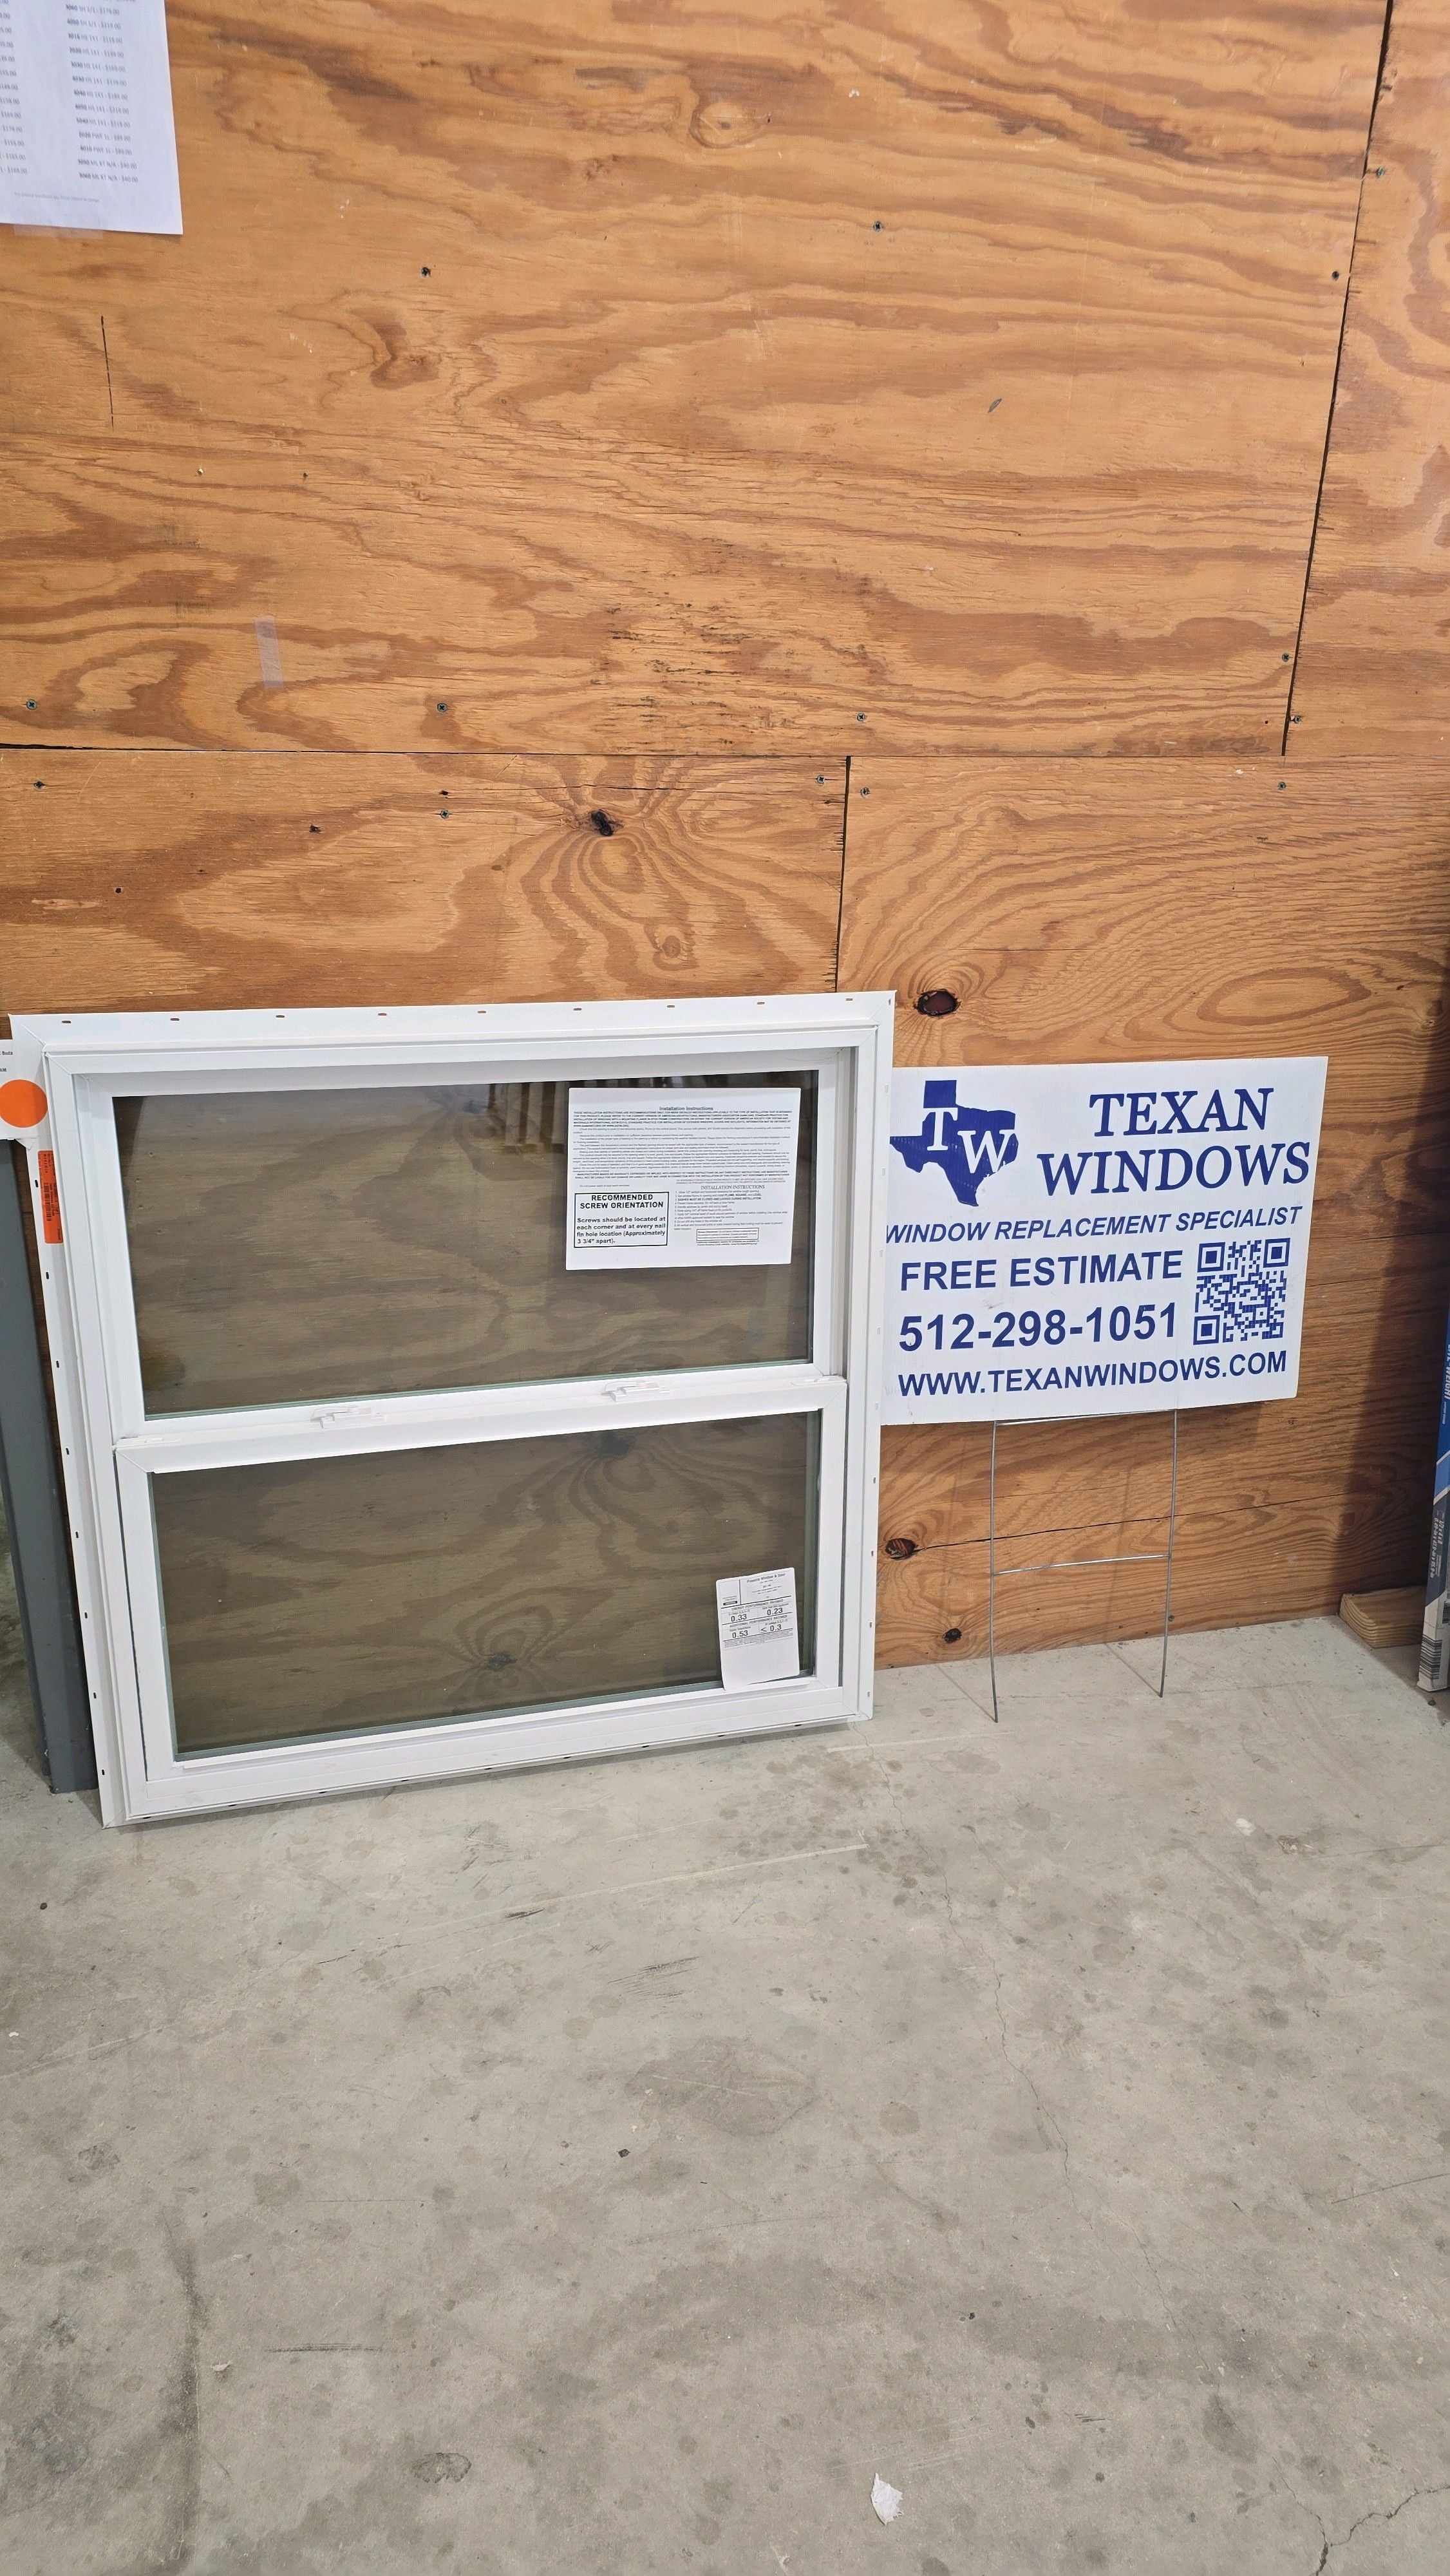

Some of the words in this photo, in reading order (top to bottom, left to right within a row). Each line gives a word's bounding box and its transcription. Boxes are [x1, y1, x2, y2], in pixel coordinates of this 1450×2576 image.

[1089, 1088, 1274, 1137] TEXAN
[921, 1107, 1015, 1174] TW
[1037, 1141, 1310, 1196] WINDOWS
[886, 1222, 990, 1244] WINDOW
[994, 1213, 1171, 1241] REPLACEMENT
[1176, 1206, 1303, 1231] SPECIALIST
[901, 1259, 997, 1291] FREE
[1010, 1250, 1183, 1287] ESTIMATE
[899, 1302, 1176, 1352] 512-298-1051
[898, 1350, 1287, 1396] WWW.TEXANWINDOWS.COM
[731, 1613, 747, 1622] 0.33
[767, 1607, 783, 1616] 0.23
[732, 1630, 748, 1638] 0.53
